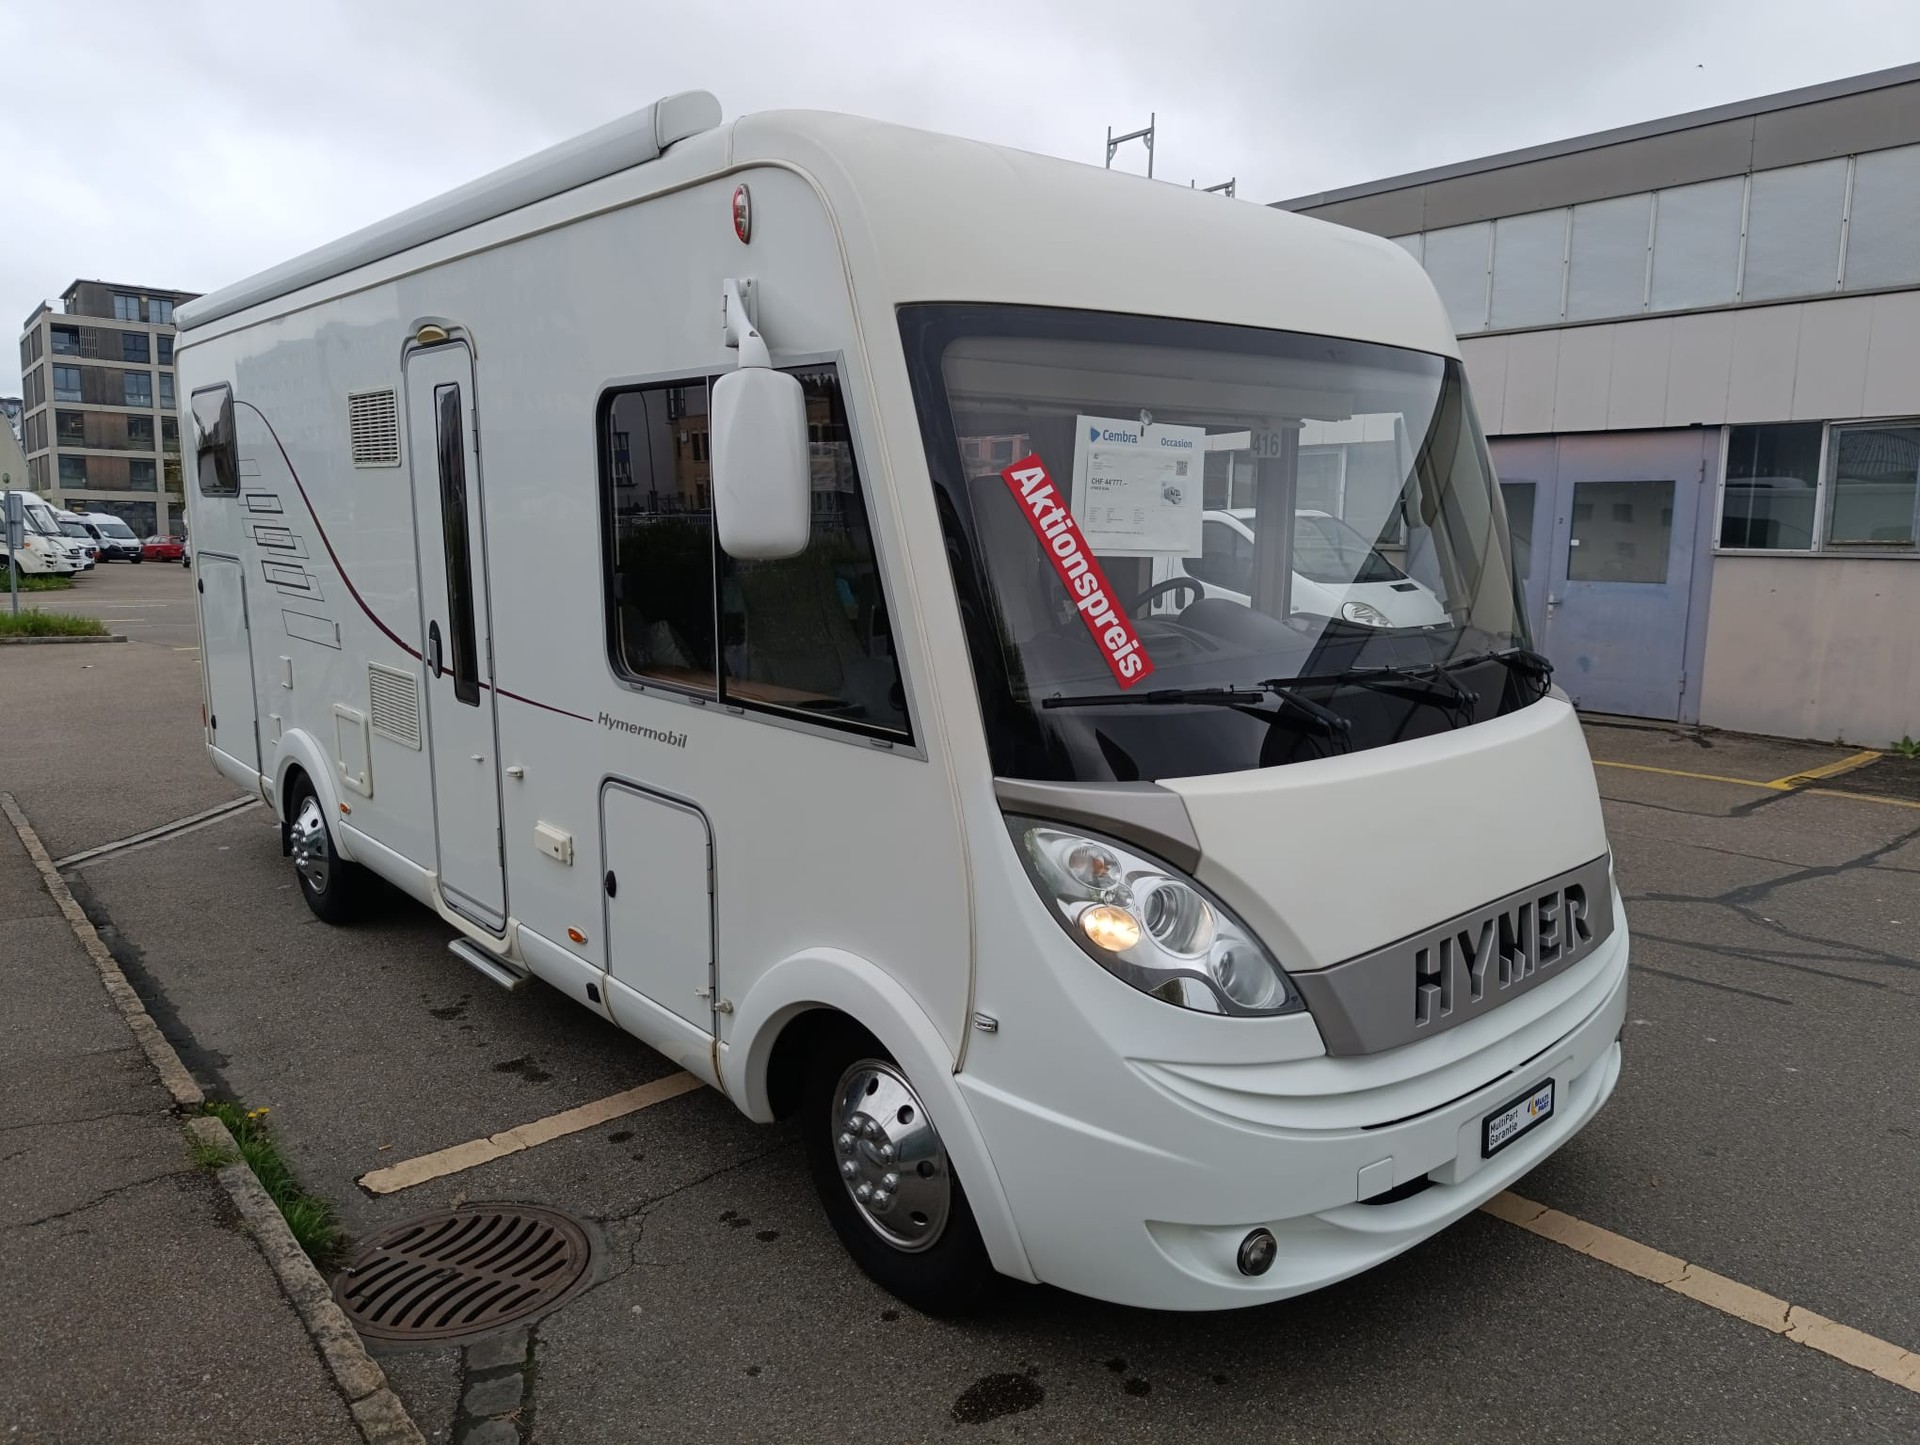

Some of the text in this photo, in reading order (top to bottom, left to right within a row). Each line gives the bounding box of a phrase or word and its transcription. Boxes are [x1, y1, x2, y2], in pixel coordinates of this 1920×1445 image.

[1102, 429, 1137, 444] Cembra
[1161, 437, 1192, 448] Occasion
[1091, 477, 1103, 485] CHF
[1011, 466, 1142, 678] Aktionspreis
[597, 711, 688, 748] Hymermobil
[1415, 883, 1593, 1027] HYMER
[1490, 1109, 1518, 1134] MultiPart
[1490, 1122, 1518, 1146] Garantie
